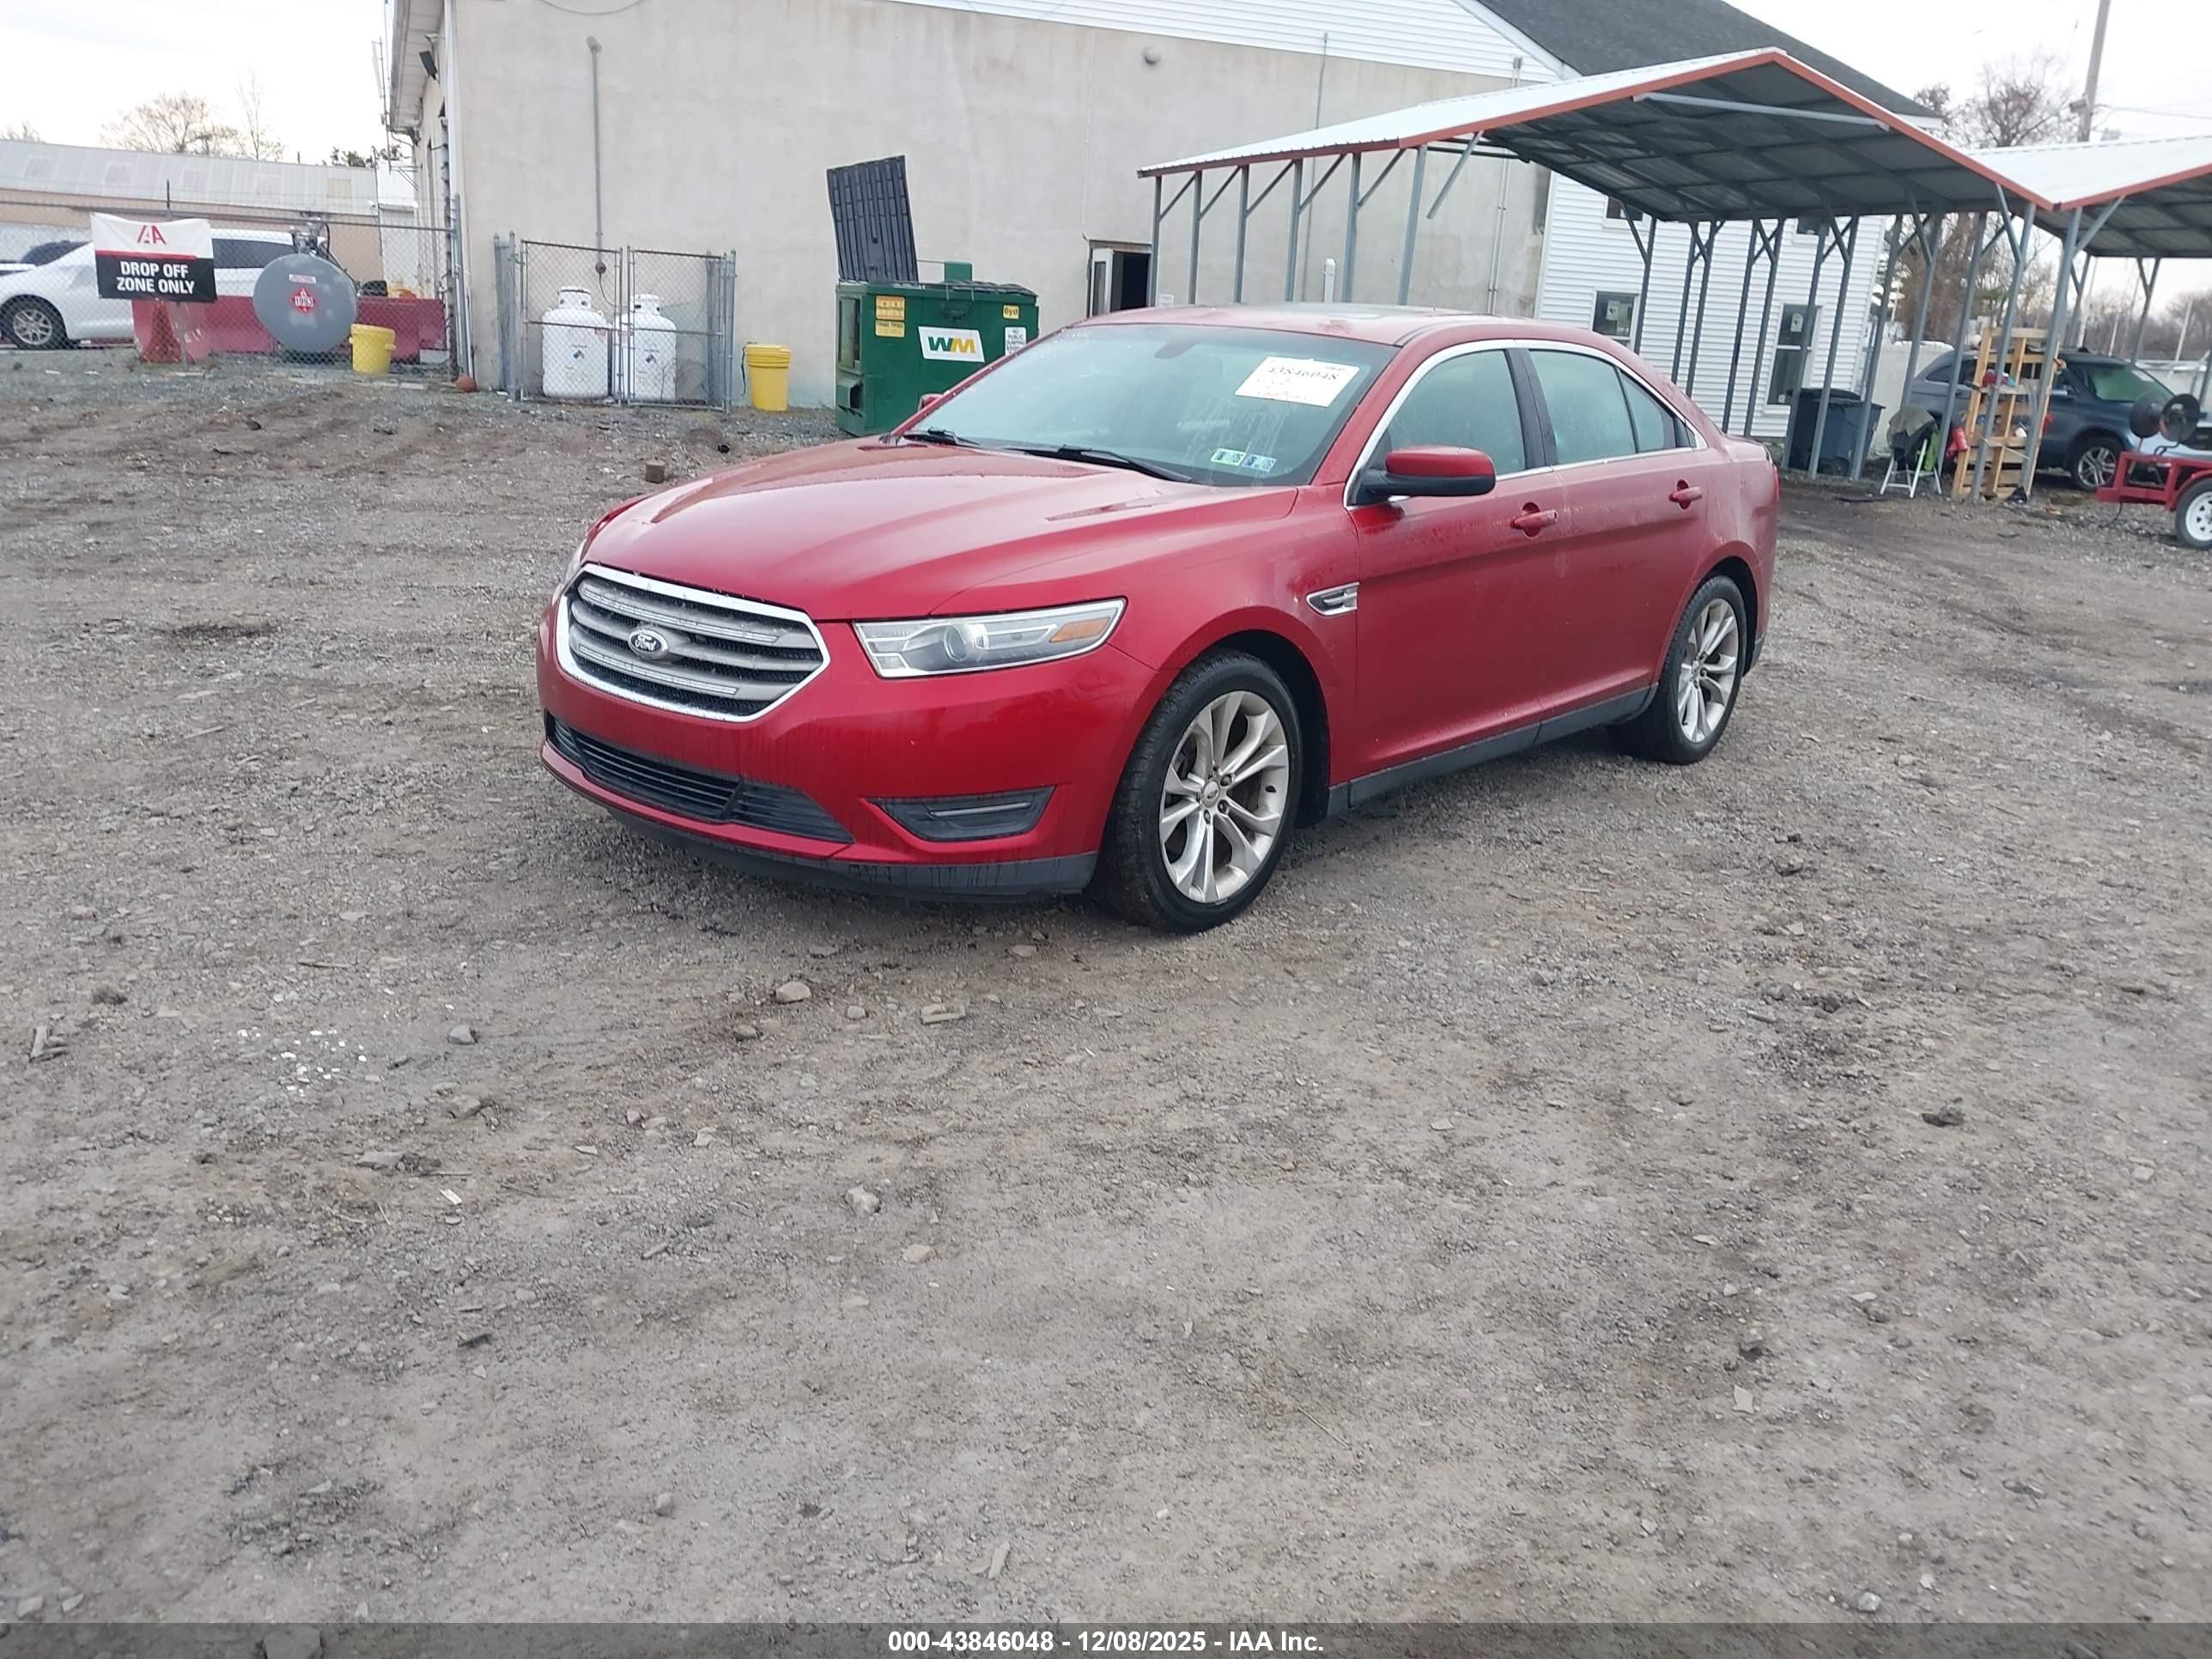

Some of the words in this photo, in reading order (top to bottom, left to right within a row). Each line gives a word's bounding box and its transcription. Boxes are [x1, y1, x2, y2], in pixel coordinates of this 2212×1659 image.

[119, 260, 160, 276] DROP
[163, 264, 189, 278] OFF
[116, 276, 155, 293] ZONE
[158, 279, 195, 295] ONLY
[928, 337, 976, 354] WM
[635, 635, 657, 652] Ford
